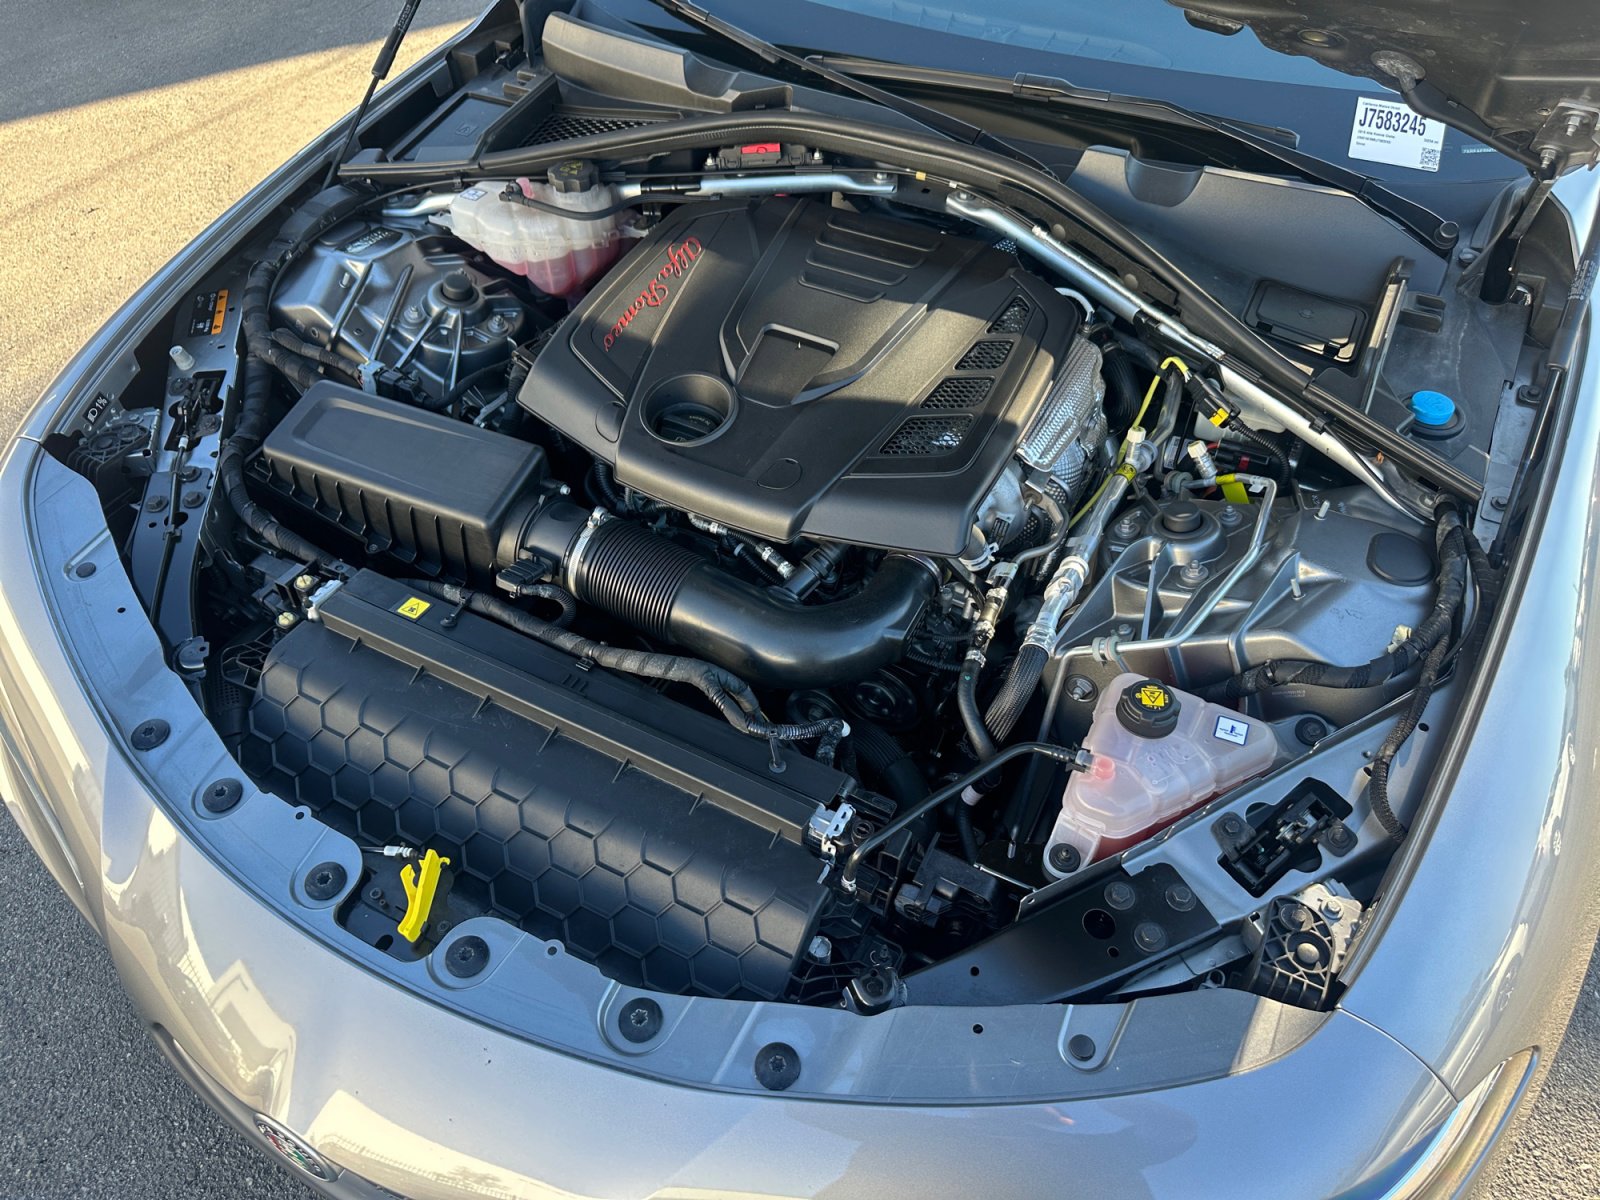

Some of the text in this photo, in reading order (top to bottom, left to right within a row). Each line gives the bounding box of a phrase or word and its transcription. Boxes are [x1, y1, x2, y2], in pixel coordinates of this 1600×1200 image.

[1358, 107, 1426, 136] J7583245
[603, 236, 702, 352] Alfa Romeo
